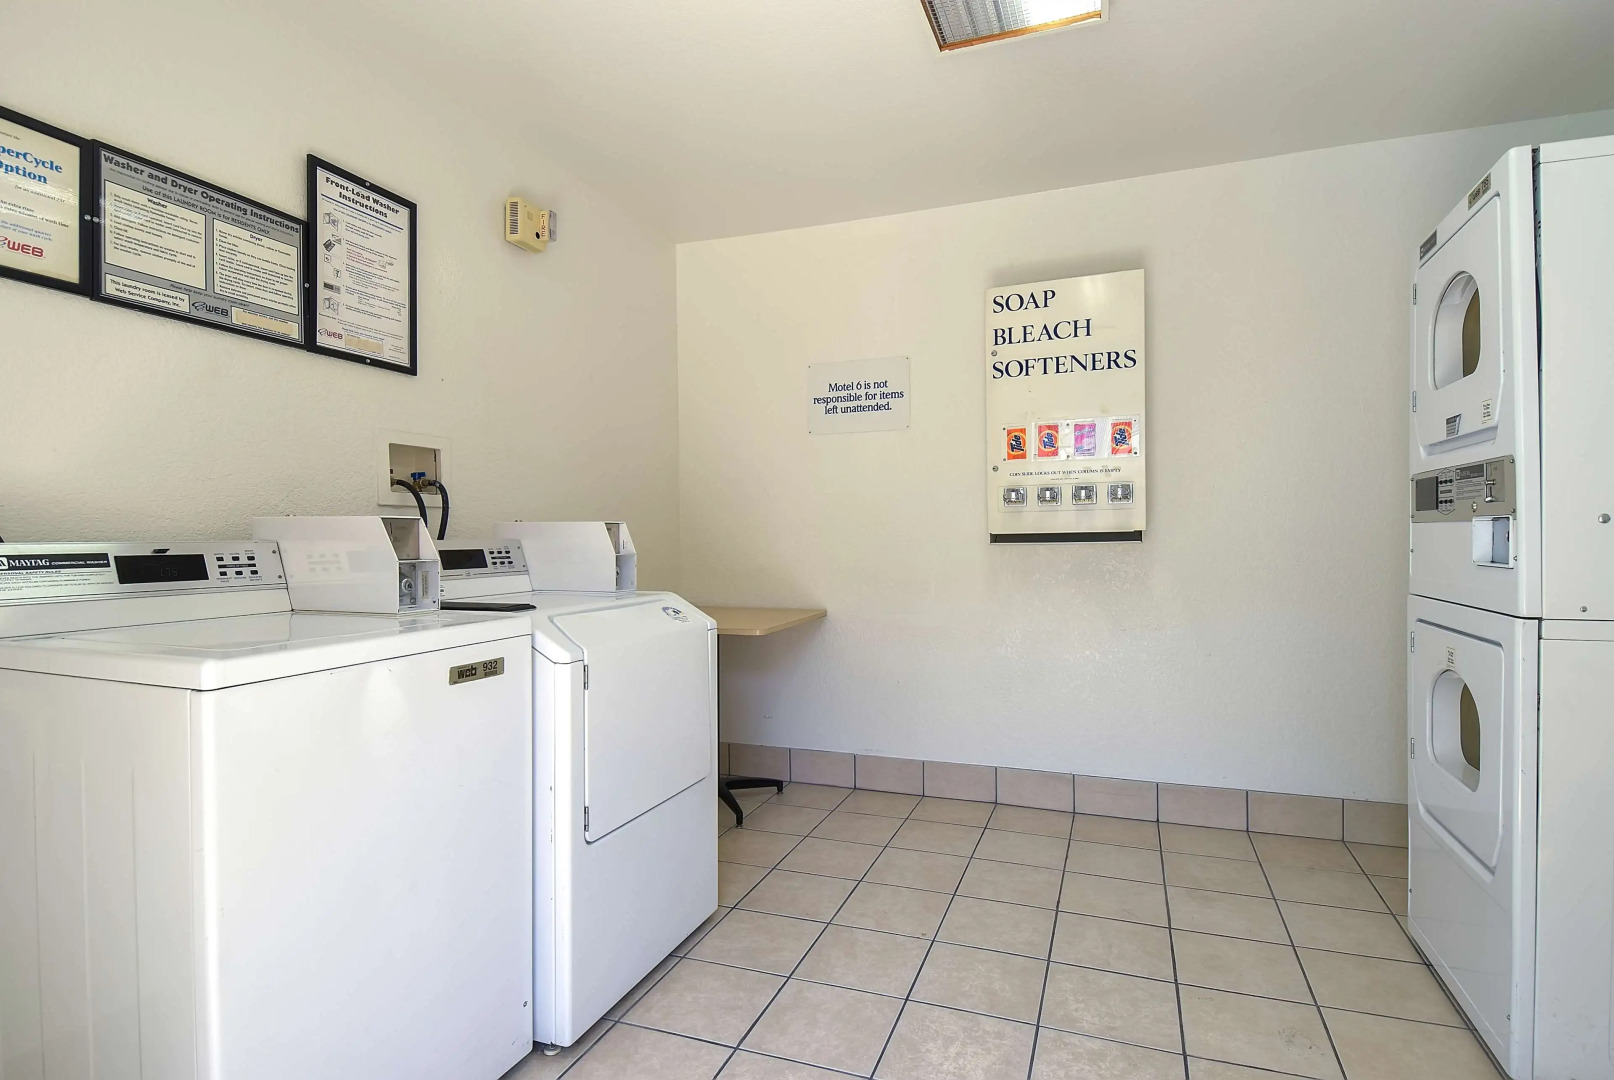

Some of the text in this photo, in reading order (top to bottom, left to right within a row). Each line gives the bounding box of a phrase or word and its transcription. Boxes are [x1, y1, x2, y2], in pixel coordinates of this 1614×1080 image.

[104, 154, 144, 176] Washer
[148, 171, 168, 185] and
[170, 178, 198, 199] Dryer
[202, 188, 247, 216] Operating
[251, 204, 300, 234] Instructions
[147, 197, 168, 209] Washer
[325, 176, 400, 215] Front-Load Washer
[163, 192, 172, 200] this
[174, 195, 198, 210] LAUNDRY
[200, 203, 216, 216] ROOM
[231, 216, 256, 230] RESIDENTS
[339, 192, 388, 218] Instructions
[250, 234, 263, 243] Dryer
[7, 240, 43, 258] WEB
[115, 287, 127, 295] Web
[128, 290, 147, 300] Service
[148, 294, 171, 306] Company,
[122, 281, 141, 293] laundry
[162, 290, 177, 300] leased
[178, 294, 185, 303] by
[992, 289, 1056, 313] SOAP
[205, 304, 229, 317] WEB
[326, 330, 343, 340] WEB
[993, 318, 1092, 346] BLEACH
[992, 349, 1136, 379] SOFTENERS
[828, 380, 888, 392] Motel 6 is not
[813, 390, 904, 405] responsible for items
[825, 402, 892, 414] left unattended.
[1010, 435, 1024, 452] Tide
[1043, 432, 1056, 450] Tide
[1114, 428, 1129, 446] Tide
[9, 559, 50, 567] MAYTAG
[458, 665, 477, 679] web
[482, 660, 498, 671] 932
